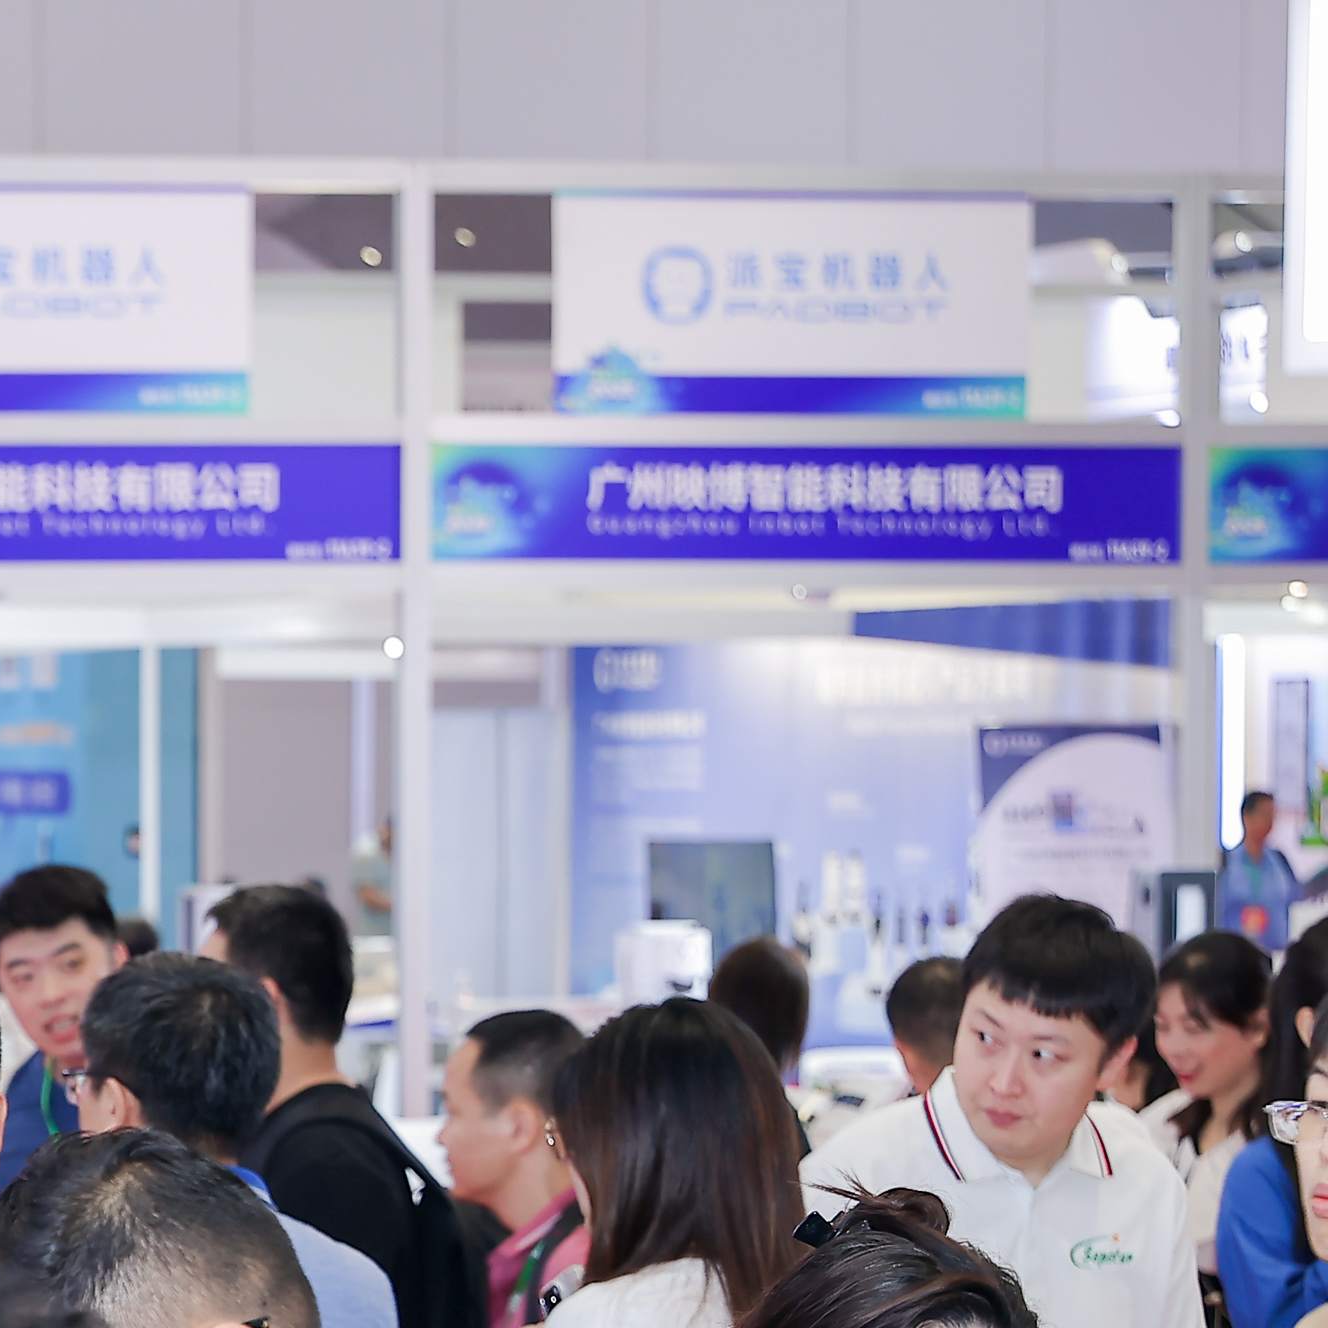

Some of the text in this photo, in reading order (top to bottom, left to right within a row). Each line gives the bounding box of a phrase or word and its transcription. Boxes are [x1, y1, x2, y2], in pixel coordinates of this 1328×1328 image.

[724, 252, 950, 290] 派宝机器人
[586, 462, 1064, 514] 广州映博智能科技有限公司
